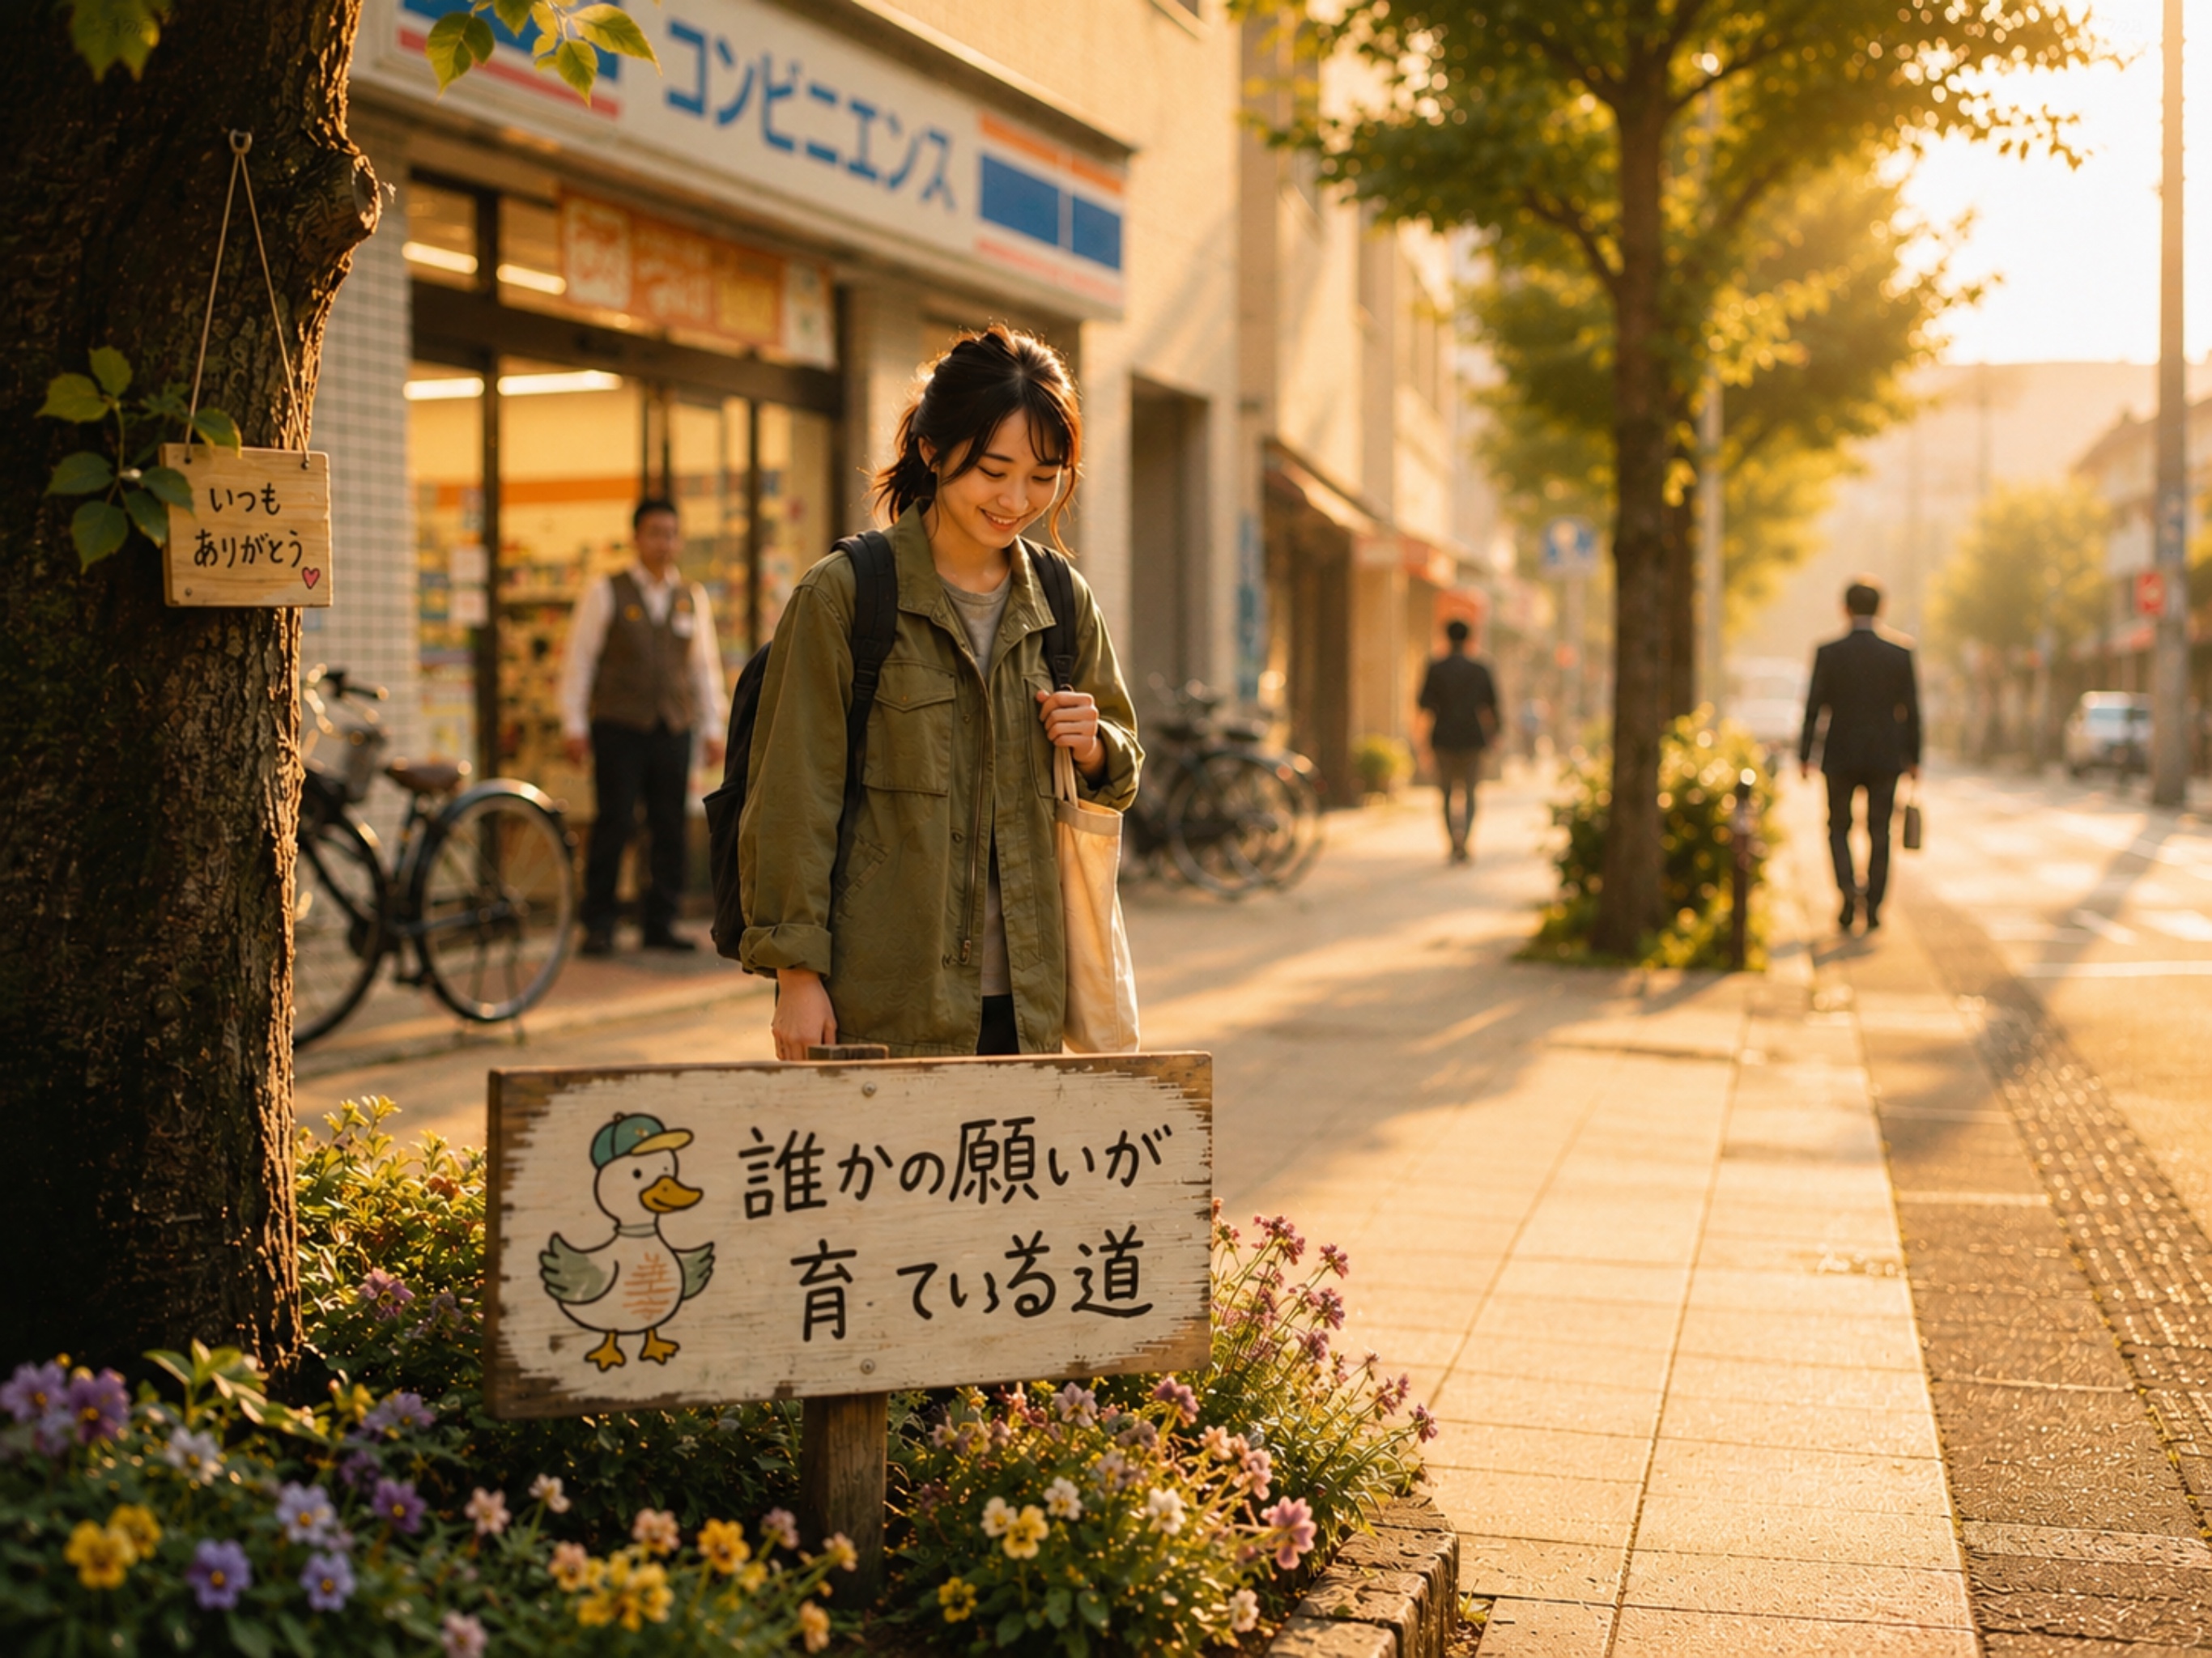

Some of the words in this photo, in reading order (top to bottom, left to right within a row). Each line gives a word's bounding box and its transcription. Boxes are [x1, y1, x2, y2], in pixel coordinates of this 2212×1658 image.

[666, 20, 956, 211] コンビニエンス
[209, 483, 281, 516] いつも
[194, 529, 303, 568] ありがとう
[738, 1116, 1172, 1219] 誰かの願いが
